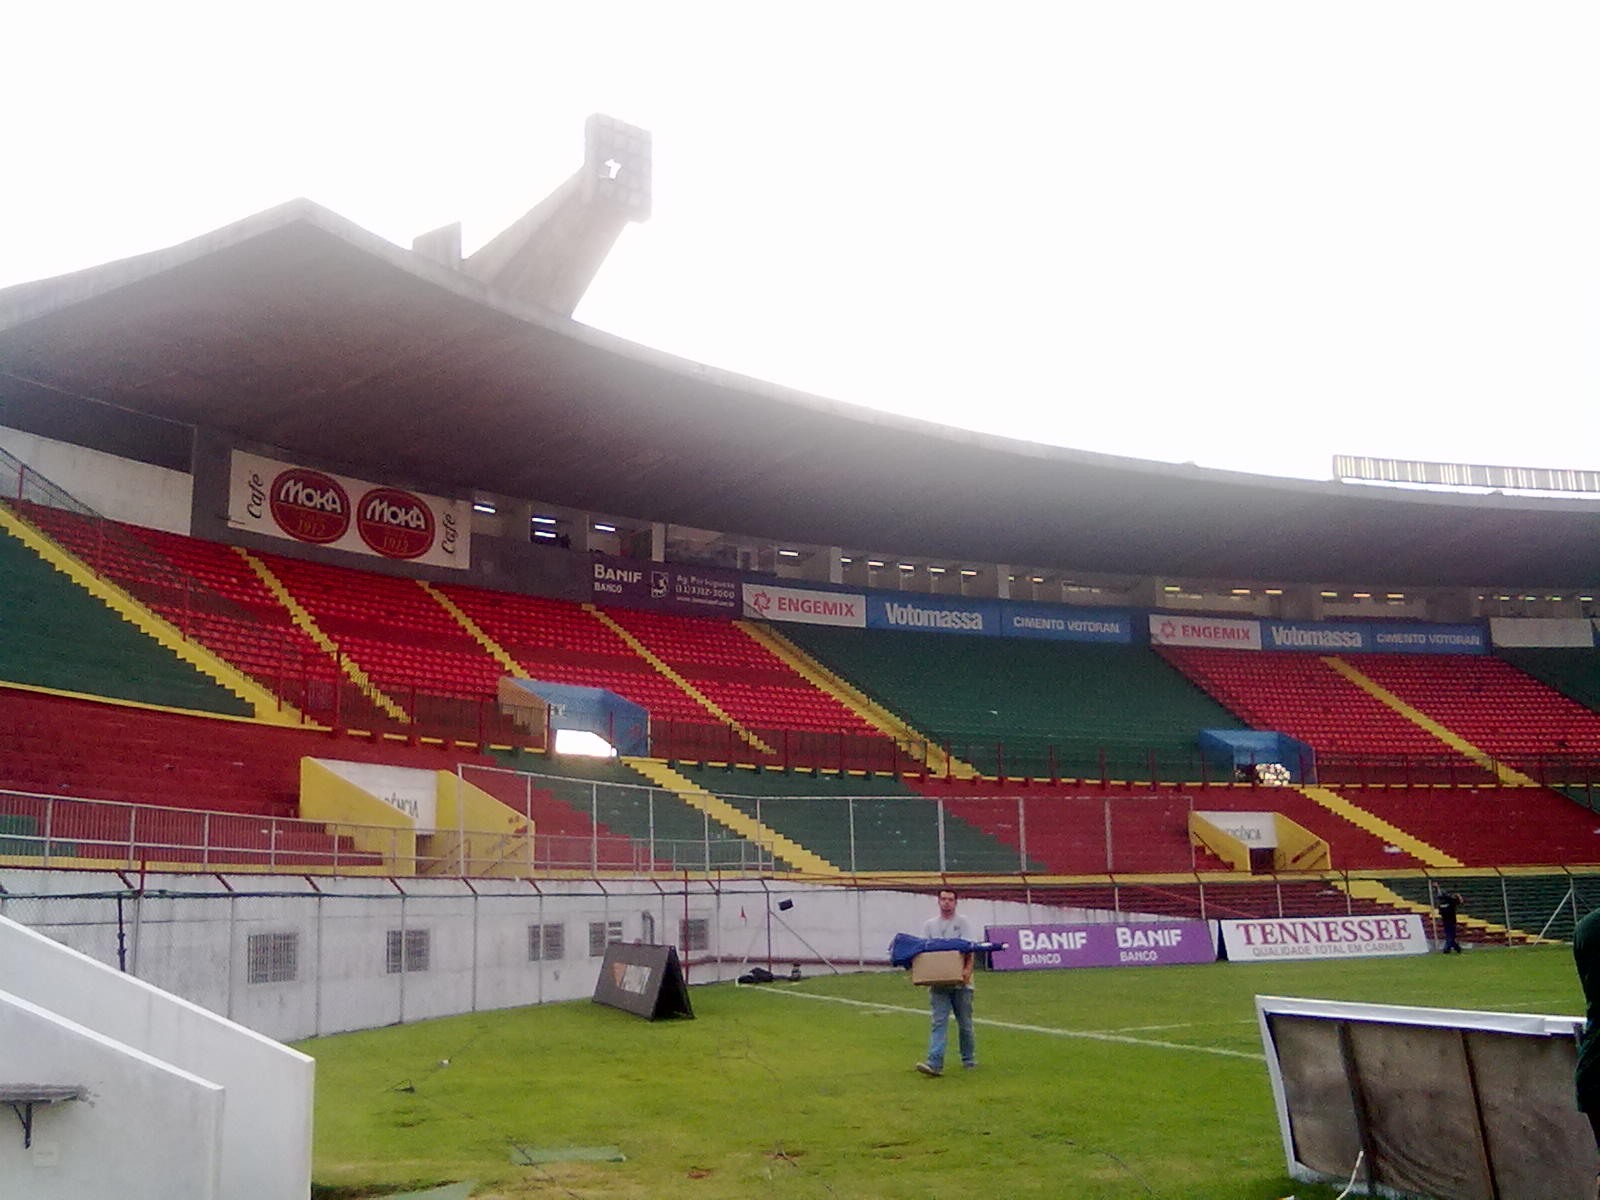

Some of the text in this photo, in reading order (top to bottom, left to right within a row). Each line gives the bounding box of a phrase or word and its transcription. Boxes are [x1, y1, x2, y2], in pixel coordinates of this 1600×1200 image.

[279, 478, 342, 513] MOKA
[366, 497, 426, 530] MOKA
[594, 564, 643, 584] BANIF
[594, 582, 623, 594] BANCO
[778, 597, 855, 617] ENGEMIX
[885, 602, 983, 630] Votomassa
[1013, 616, 1120, 634] CIMENTO VOTORAN
[1181, 624, 1250, 641] ENGEMIX
[1271, 626, 1362, 647] Votomassa
[1376, 632, 1480, 646] CIMENTO VOTORAN
[1018, 928, 1088, 951] BANIF
[1115, 925, 1183, 948] BANIF
[1236, 917, 1412, 946] TENNESSEE
[1022, 953, 1062, 966] BANCO
[1120, 950, 1158, 962] BANCO
[1252, 941, 1405, 958] QUALIDADE TOTAL EM CARNES
